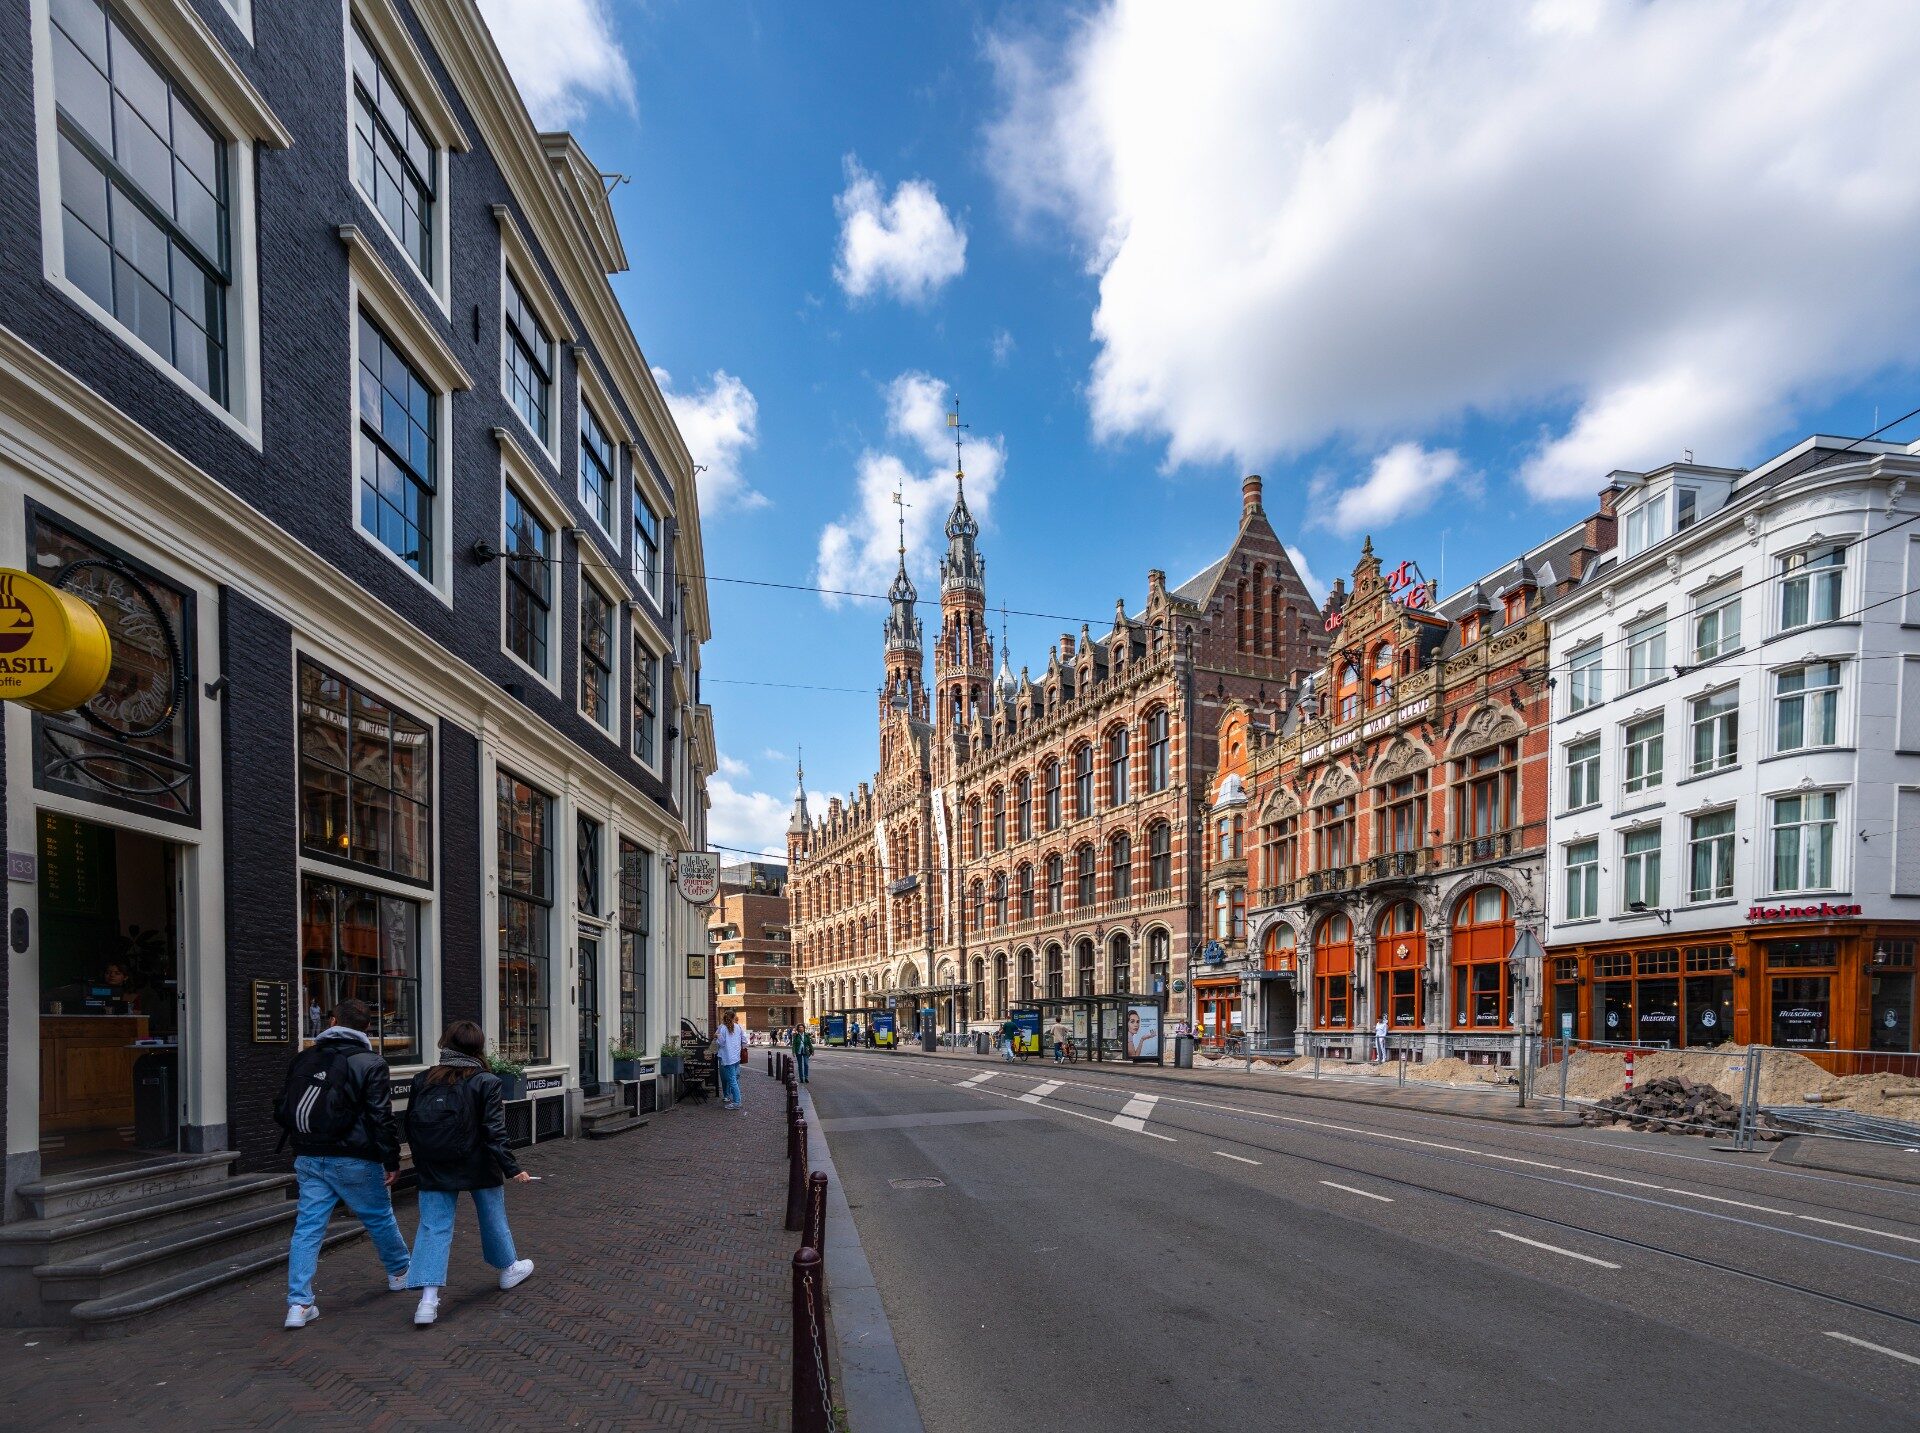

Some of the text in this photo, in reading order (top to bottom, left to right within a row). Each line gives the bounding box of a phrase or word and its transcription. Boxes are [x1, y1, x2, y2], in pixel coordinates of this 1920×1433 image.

[1369, 717, 1387, 733] VAN
[1400, 698, 1429, 720] CLEVE
[11, 859, 33, 875] 133
[685, 855, 710, 867] Melly's
[683, 878, 715, 888] gourmet
[687, 885, 710, 896] Coffee
[1748, 902, 1863, 920] Heineken
